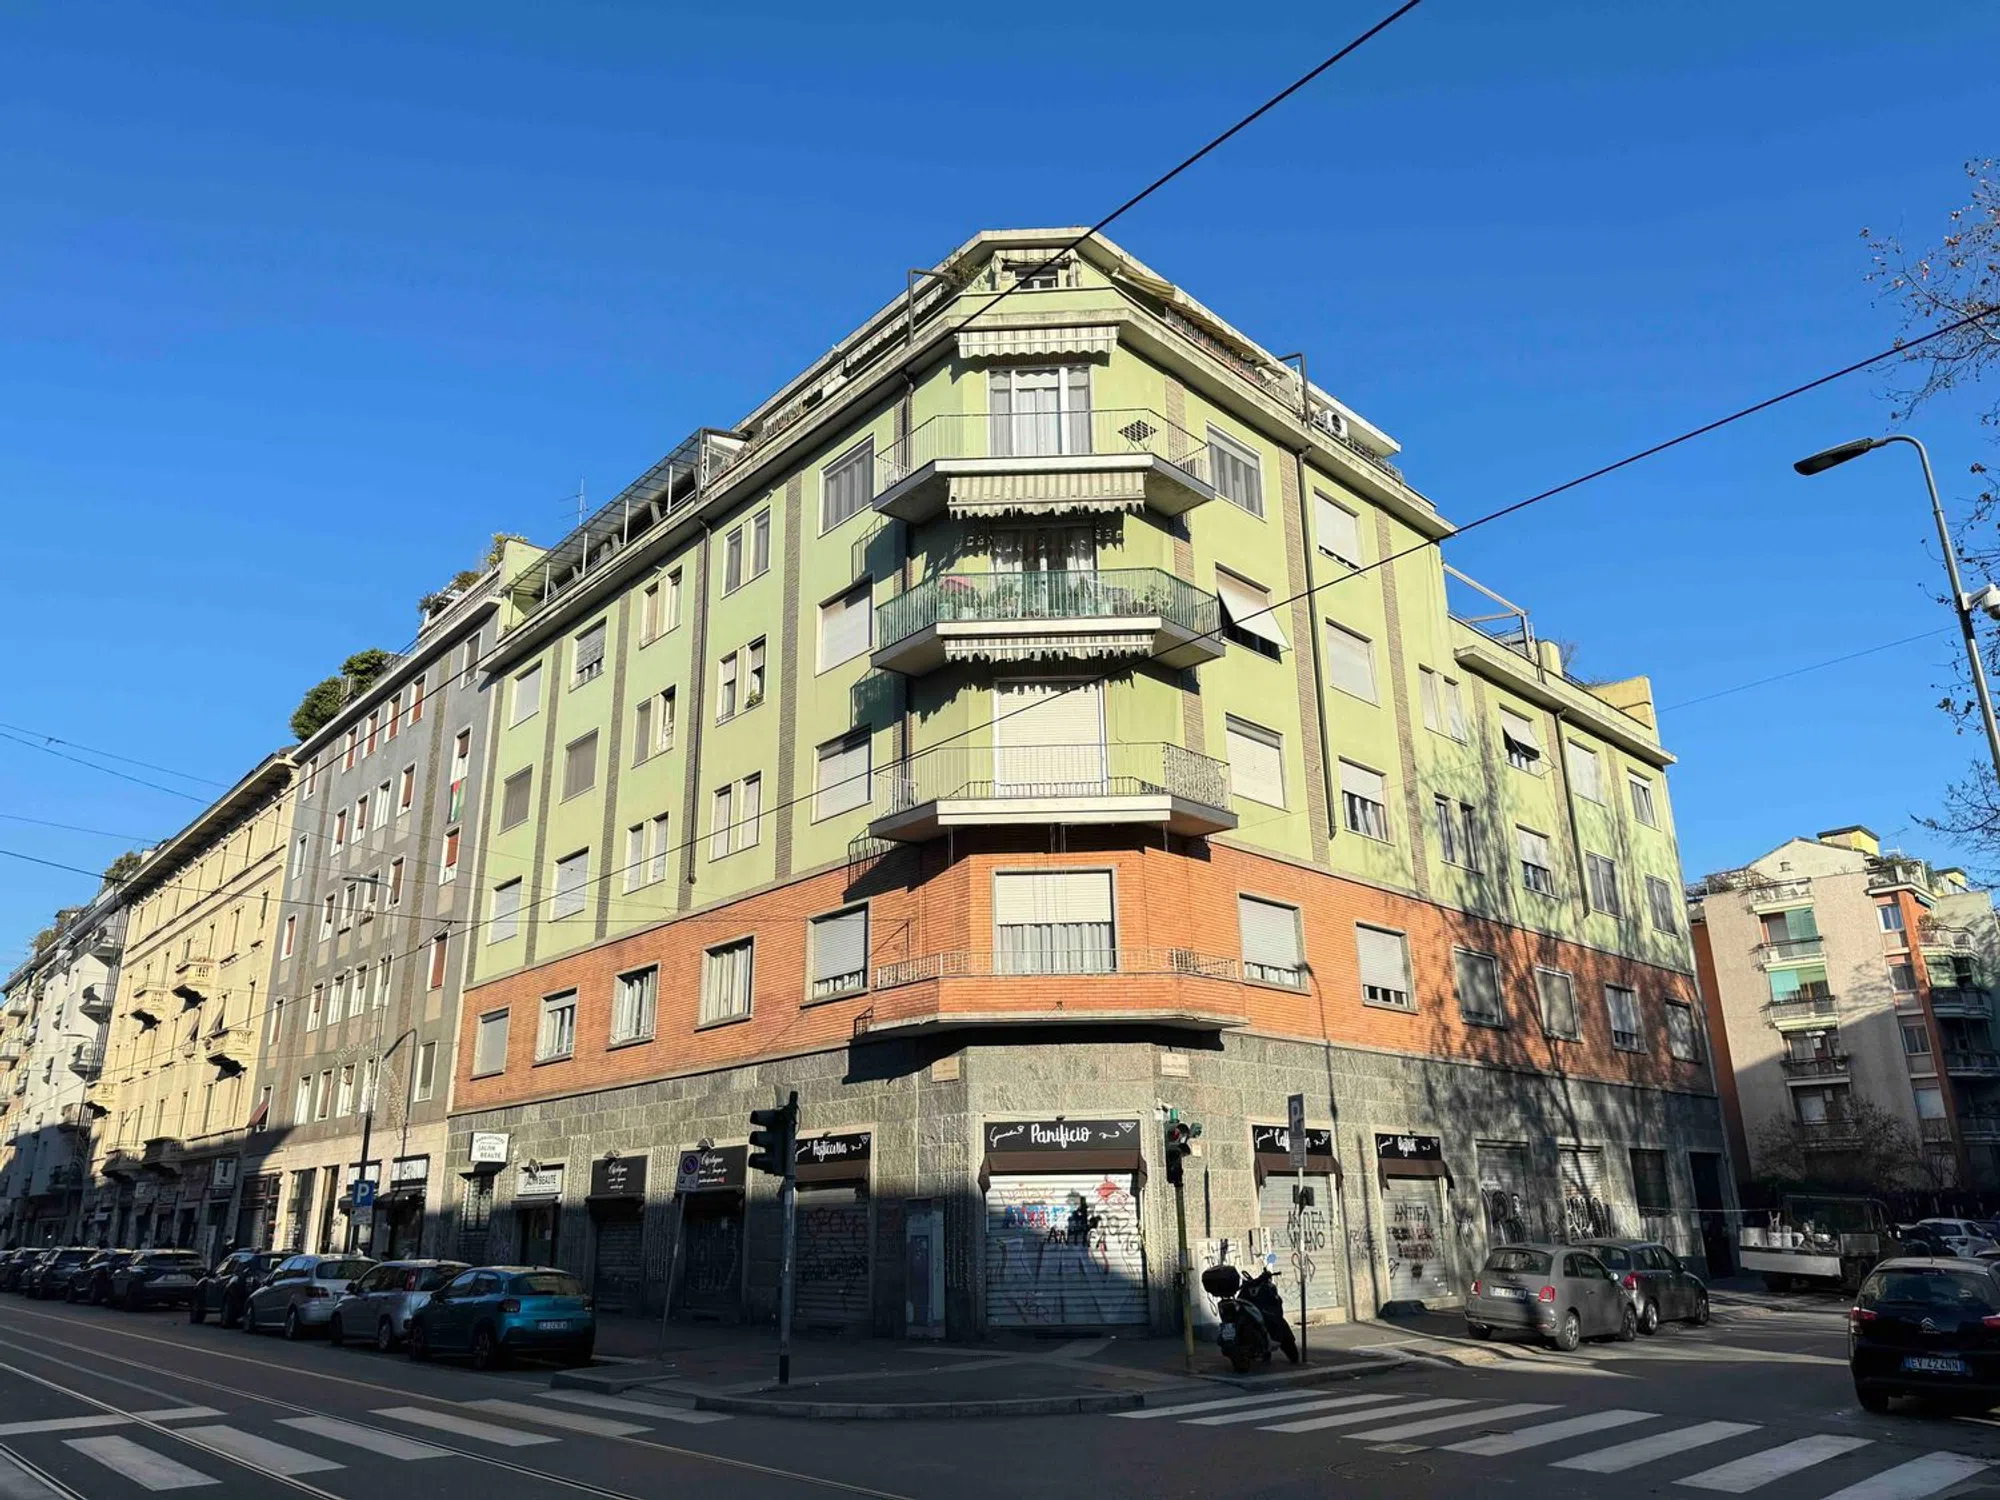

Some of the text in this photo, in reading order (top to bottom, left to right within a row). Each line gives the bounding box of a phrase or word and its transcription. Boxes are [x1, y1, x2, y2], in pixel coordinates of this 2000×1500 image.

[1030, 1123, 1092, 1149] Panificio
[356, 1183, 370, 1203] P
[1394, 1204, 1430, 1223] ANTIFA
